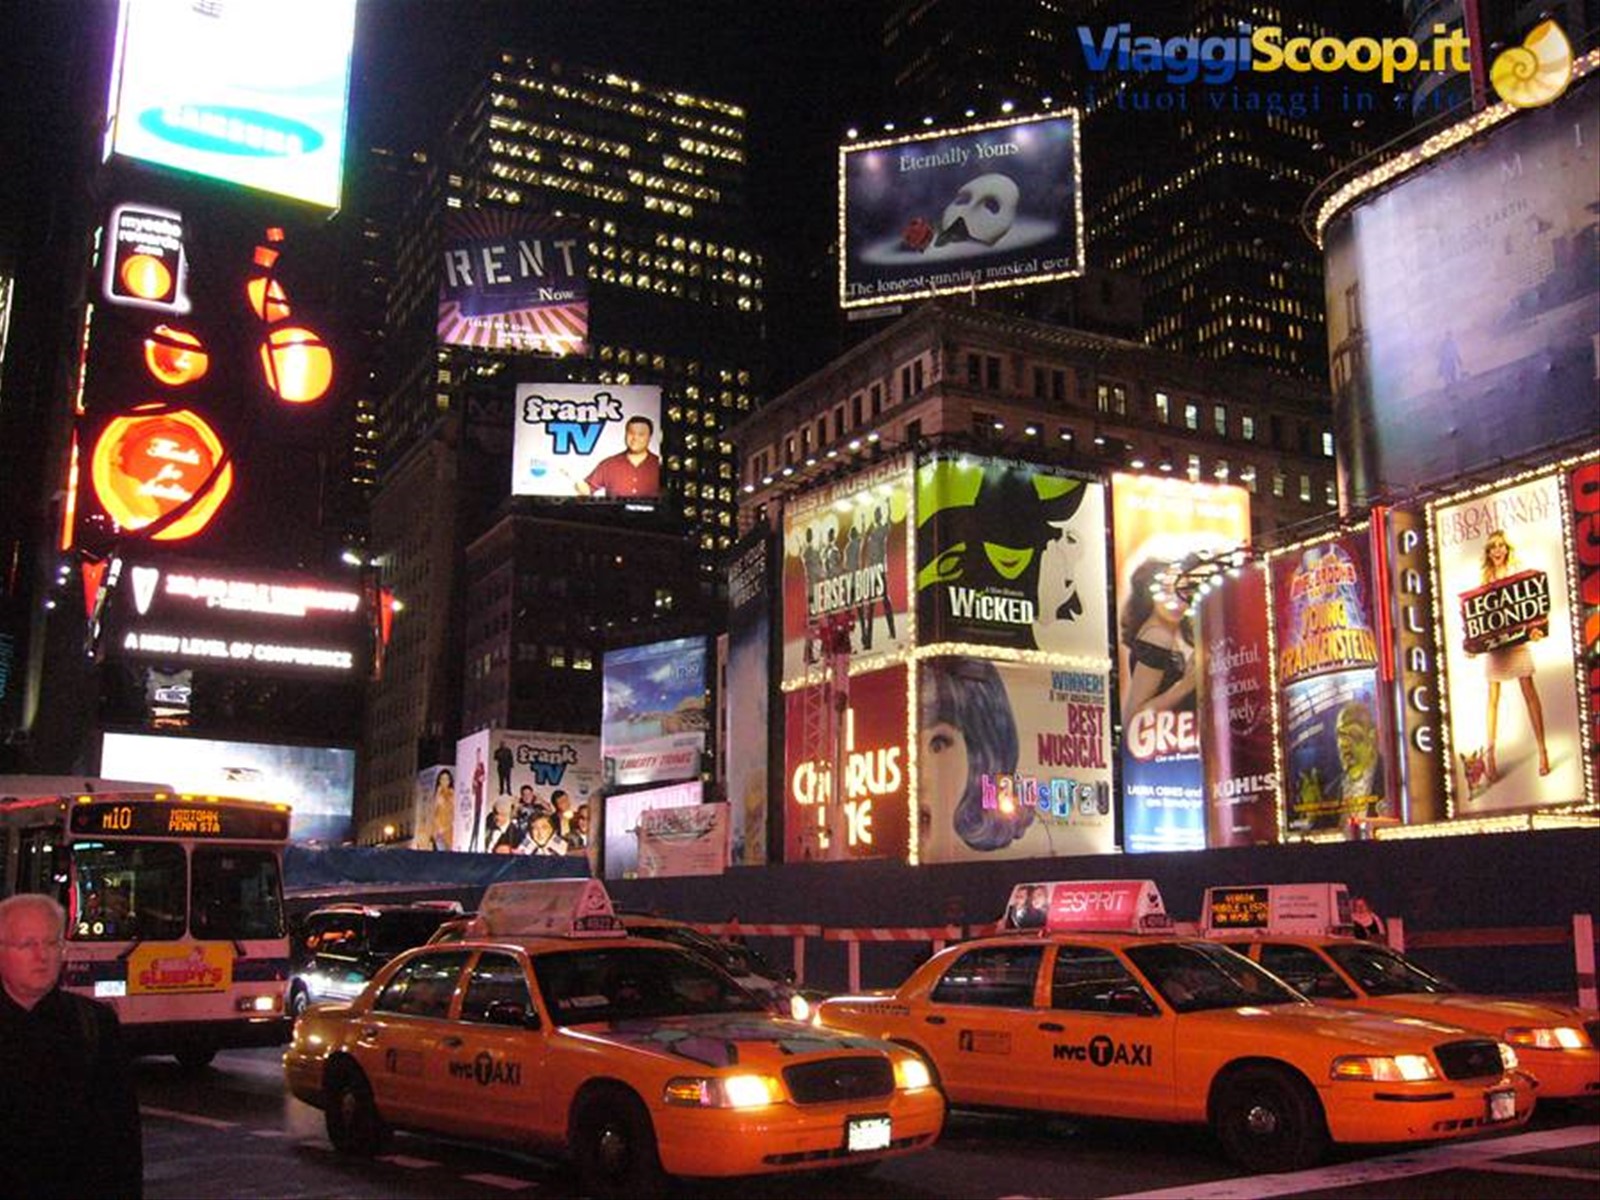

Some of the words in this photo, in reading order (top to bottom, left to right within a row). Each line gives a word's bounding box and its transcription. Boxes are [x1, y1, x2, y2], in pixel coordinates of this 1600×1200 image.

[900, 147, 971, 173] Eternally
[975, 140, 1020, 161] Yours
[446, 239, 578, 288] RENT
[848, 282, 874, 297] The
[877, 268, 983, 293] longest-running
[986, 258, 1039, 280] musical
[1042, 257, 1071, 272] ever
[538, 287, 575, 302] Now
[523, 392, 623, 424] frank
[545, 420, 607, 456] TV
[1440, 484, 1552, 531] BROADWAY
[811, 570, 852, 615] JERSEY
[853, 564, 885, 604] BOYS
[1464, 573, 1546, 620] LEGALLY
[1467, 594, 1549, 639] BLONDE
[123, 631, 139, 650] A
[139, 633, 181, 653] NEW
[181, 637, 230, 658] LEVEL
[230, 641, 254, 660] OF
[1280, 627, 1379, 678] FRANKENSTEIN
[1402, 530, 1433, 753] PALACE
[1067, 702, 1105, 738] BEST
[1126, 706, 1201, 764] GRE
[516, 743, 578, 765] frank
[1037, 731, 1107, 769] MUSICAL
[530, 758, 568, 786] TV
[1213, 772, 1278, 800] KOHL'S
[981, 771, 1111, 819] hairspray
[168, 820, 197, 832] PENN
[199, 821, 221, 833] STA
[1058, 890, 1130, 913] ESPRIT
[1053, 1043, 1087, 1061] NYC
[1088, 1034, 1153, 1068] TAXI
